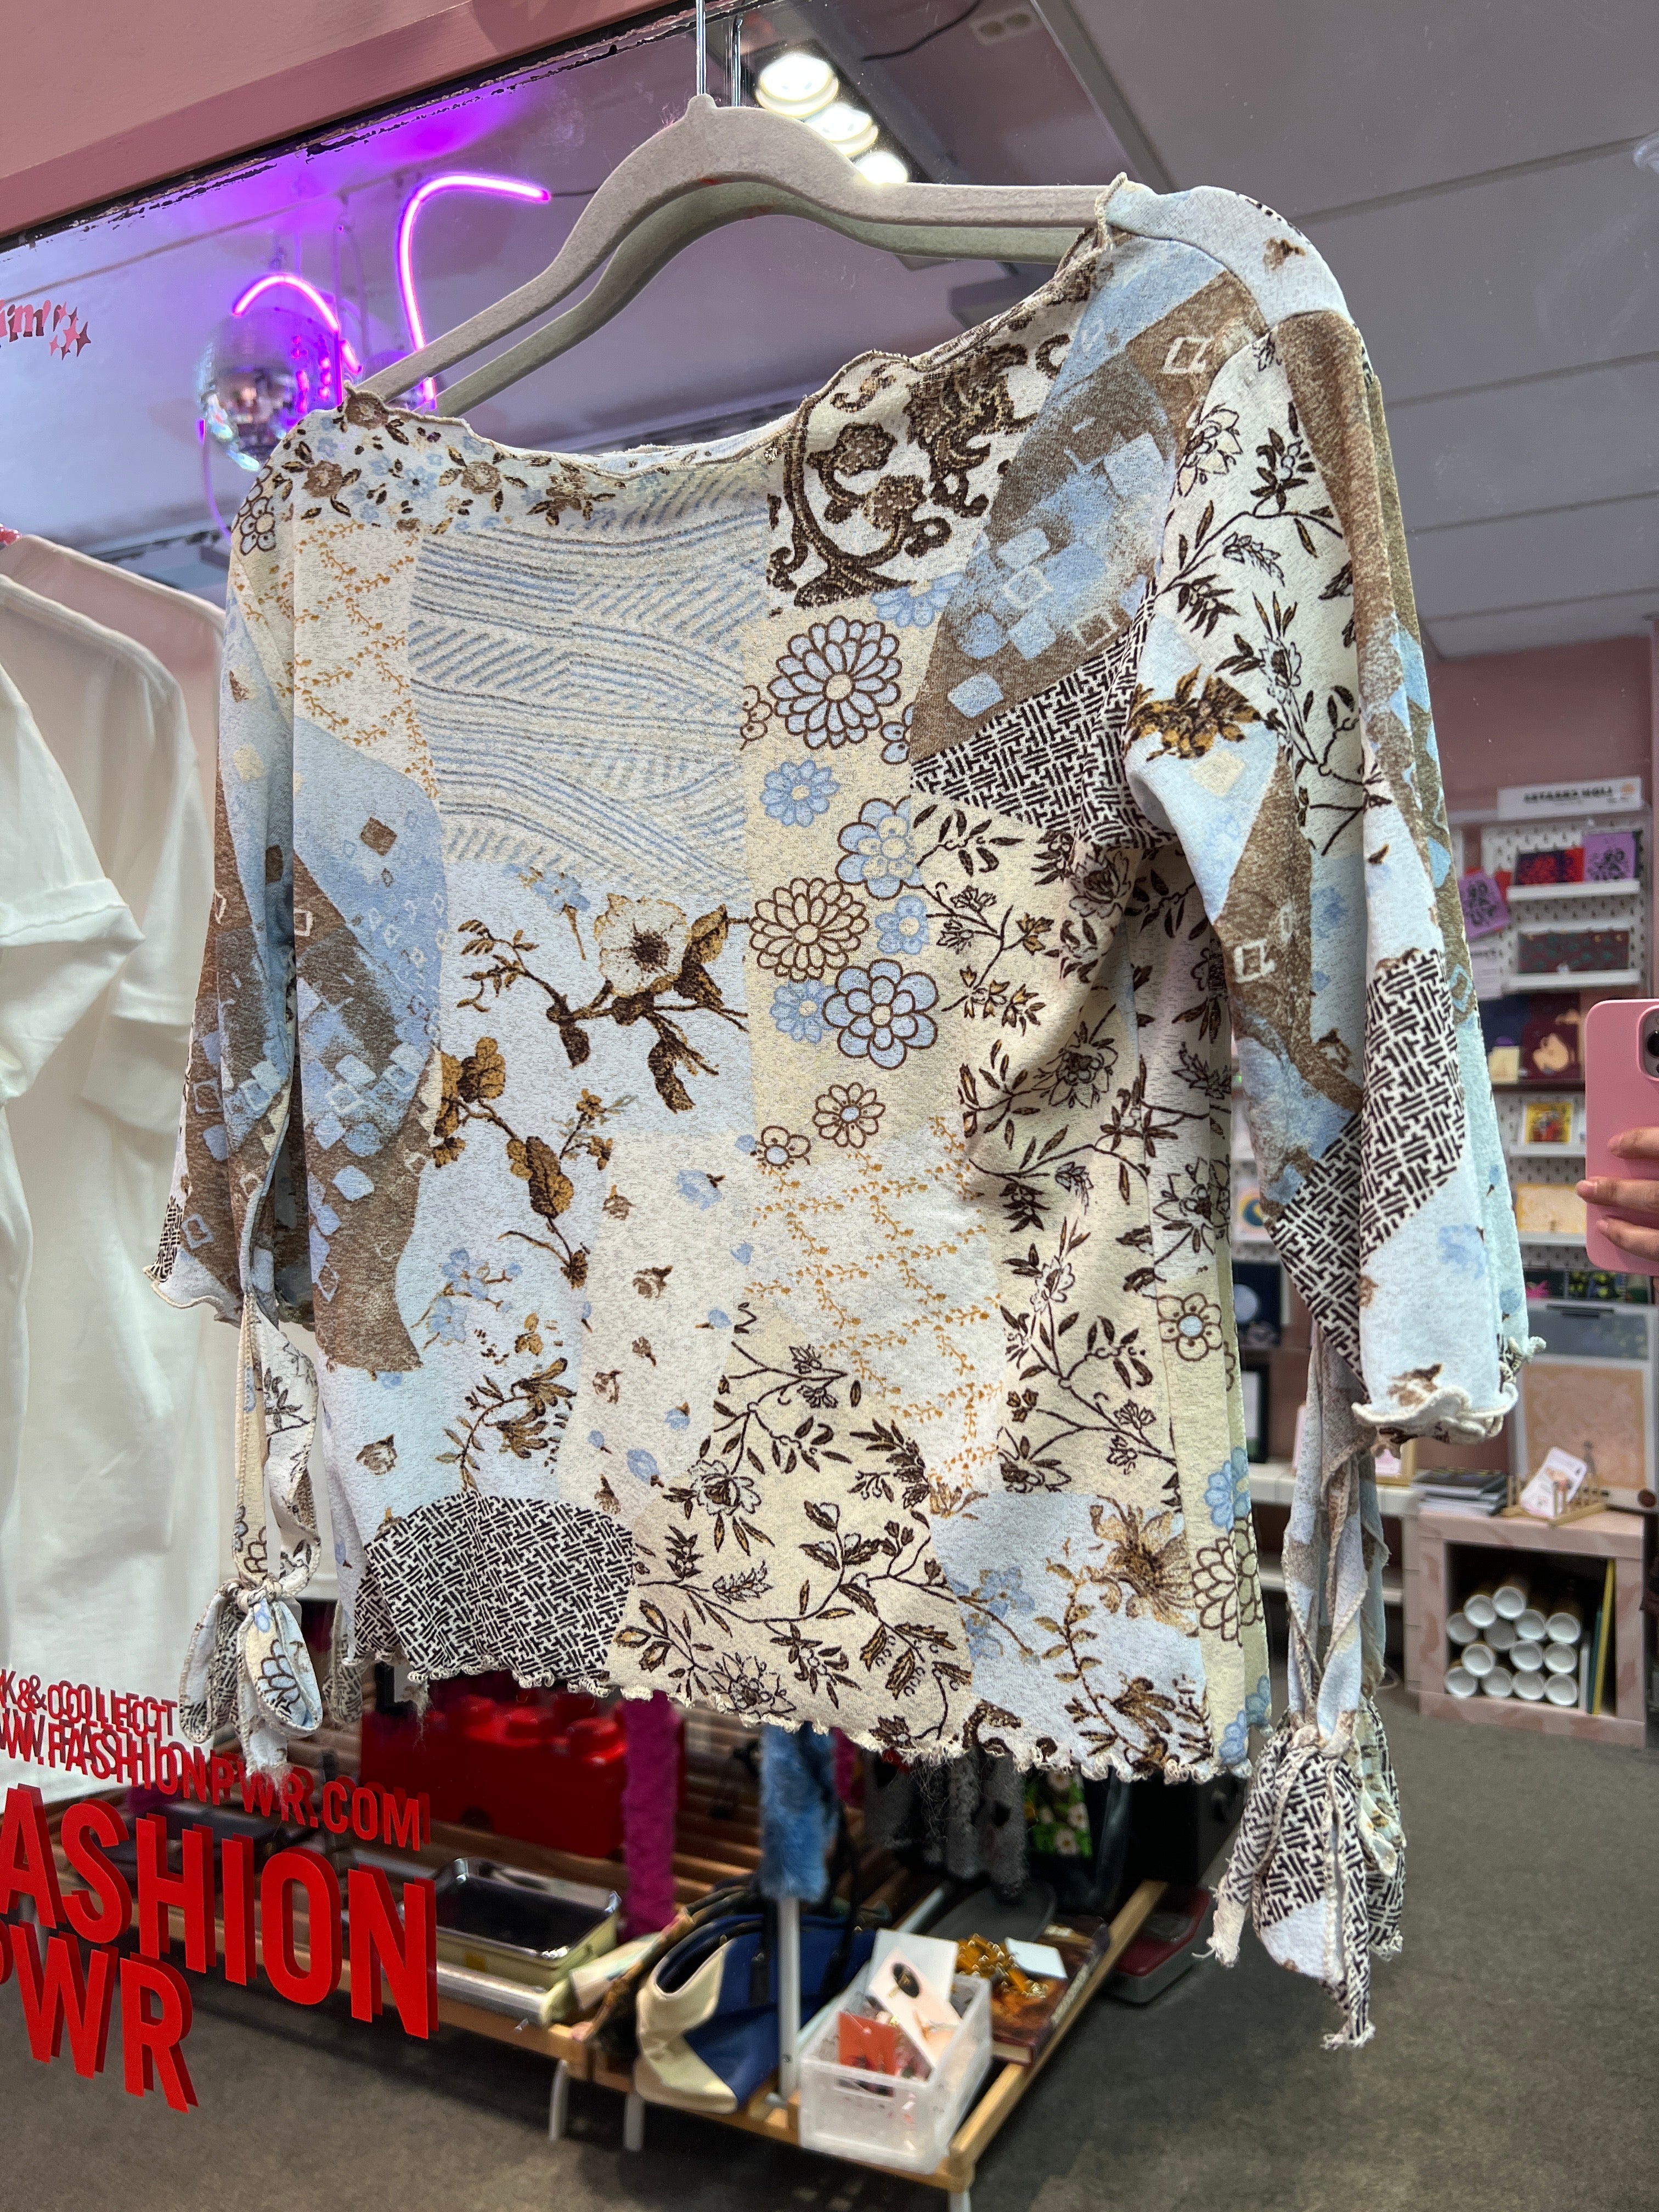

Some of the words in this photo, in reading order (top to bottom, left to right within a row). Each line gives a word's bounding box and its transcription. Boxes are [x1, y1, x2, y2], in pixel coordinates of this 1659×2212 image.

[17, 1678, 37, 1715] &
[48, 1684, 168, 1741] COLLECT
[0, 1787, 429, 2040] ASHION
[0, 1925, 190, 2114] WR
